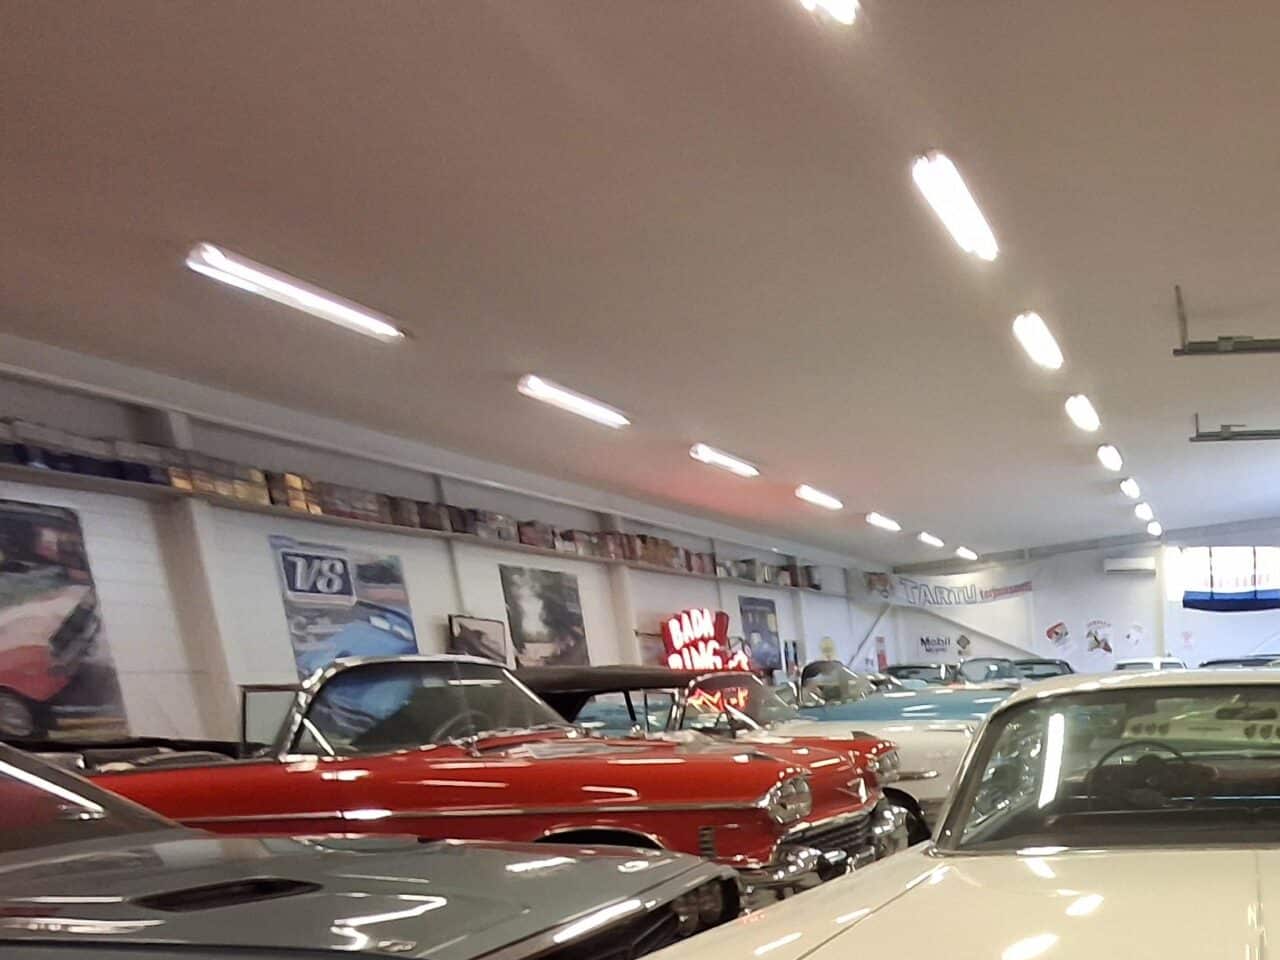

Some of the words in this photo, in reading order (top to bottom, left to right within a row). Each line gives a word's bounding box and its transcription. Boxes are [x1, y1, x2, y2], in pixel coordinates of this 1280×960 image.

[287, 556, 345, 593] V8
[898, 576, 977, 606] TARTU
[667, 608, 715, 650] BADA
